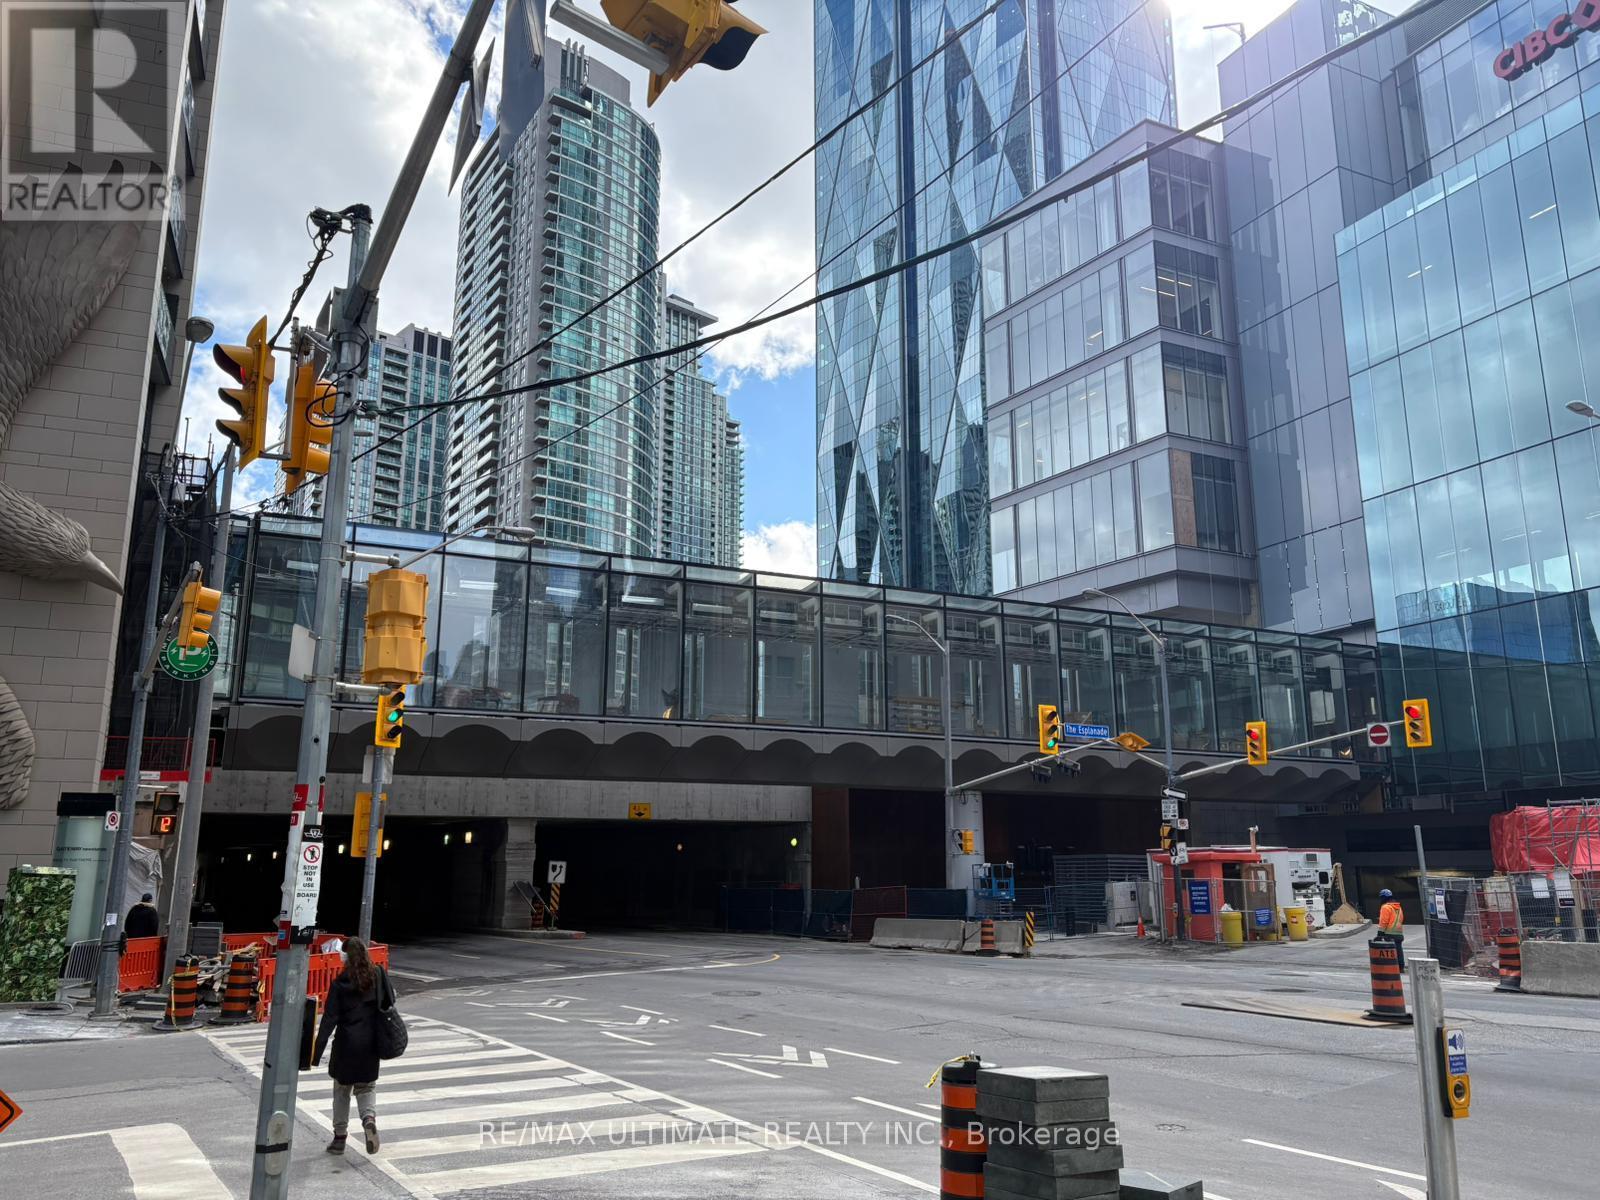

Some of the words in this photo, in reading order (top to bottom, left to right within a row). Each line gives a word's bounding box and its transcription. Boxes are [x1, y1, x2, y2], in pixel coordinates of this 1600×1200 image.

[1493, 14, 1571, 79] CIBC
[160, 655, 216, 679] PARKING
[1066, 724, 1077, 734] The
[1079, 726, 1107, 736] Esplanade
